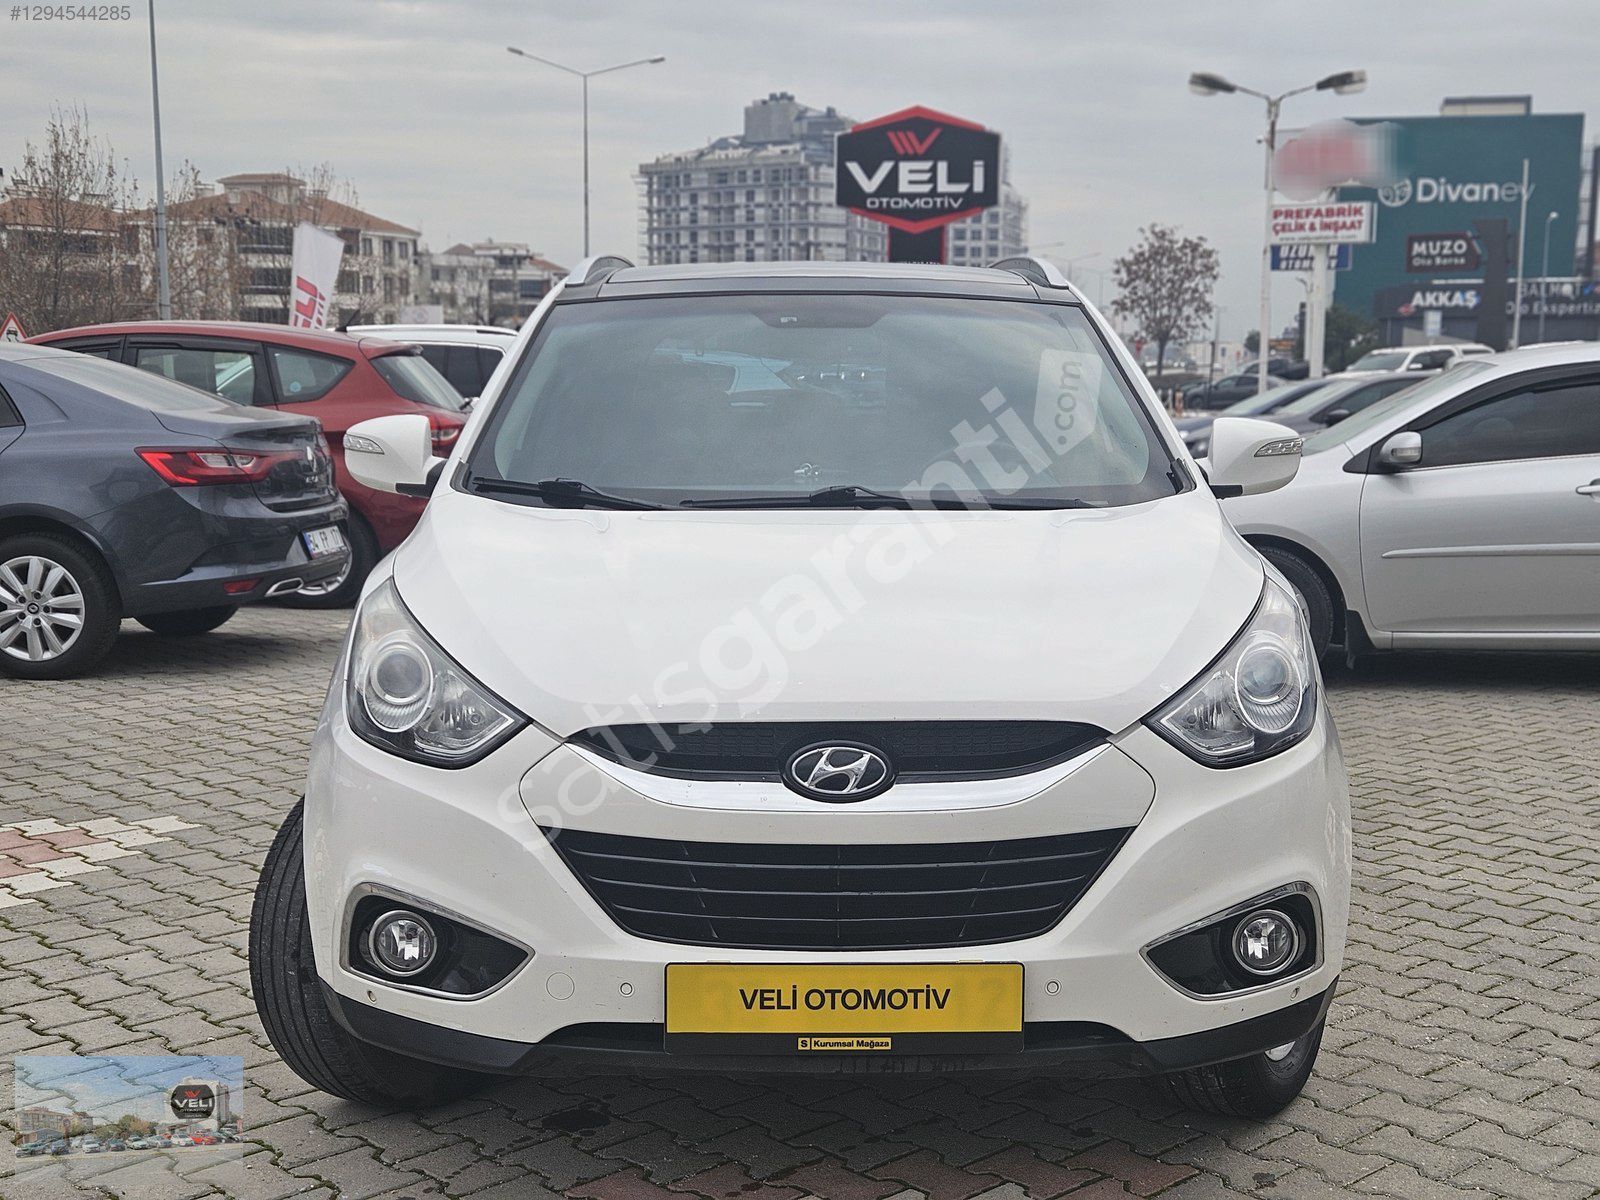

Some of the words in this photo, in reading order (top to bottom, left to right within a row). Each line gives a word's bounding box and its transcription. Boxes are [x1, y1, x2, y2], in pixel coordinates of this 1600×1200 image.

[866, 195, 964, 209] OTOMOTİV
[1272, 205, 1365, 219] PREFABRİK
[1411, 240, 1468, 256] MUZO
